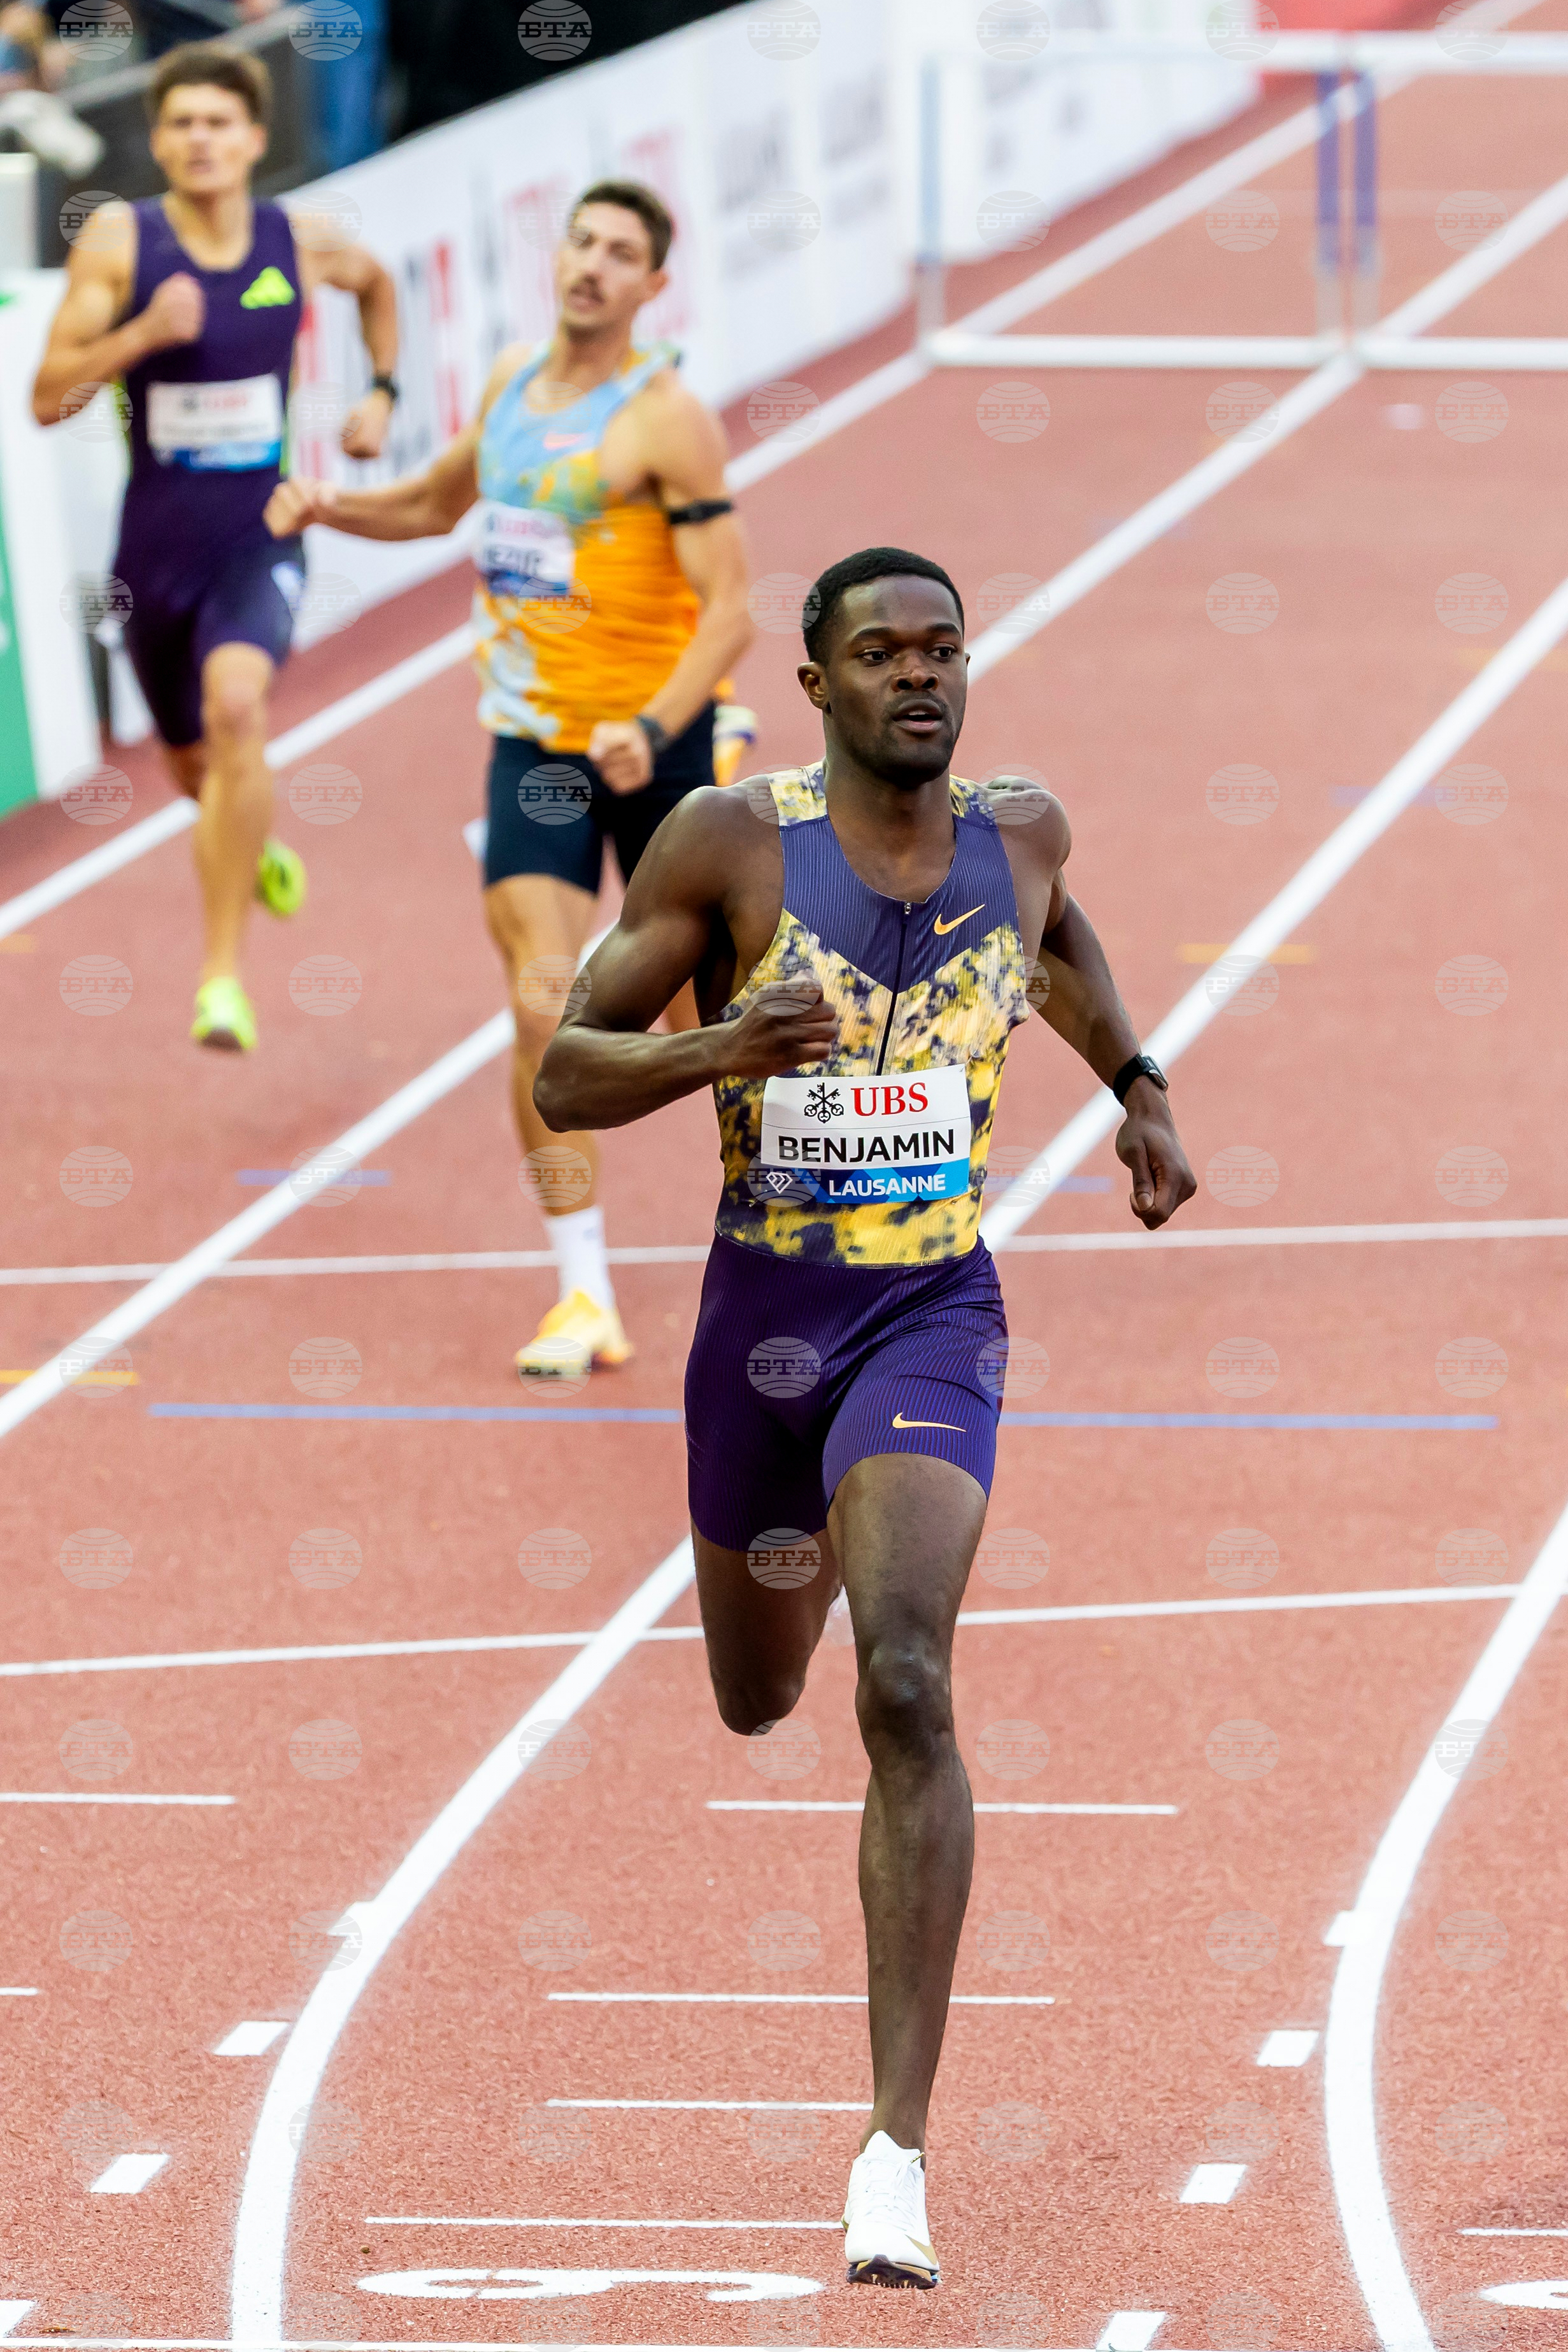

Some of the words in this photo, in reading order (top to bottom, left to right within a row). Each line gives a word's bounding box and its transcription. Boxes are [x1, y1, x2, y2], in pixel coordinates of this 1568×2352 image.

[851, 1083, 929, 1116] UBS
[778, 1129, 955, 1163] BENJAMIN
[829, 1174, 946, 1197] LAUSANNE
